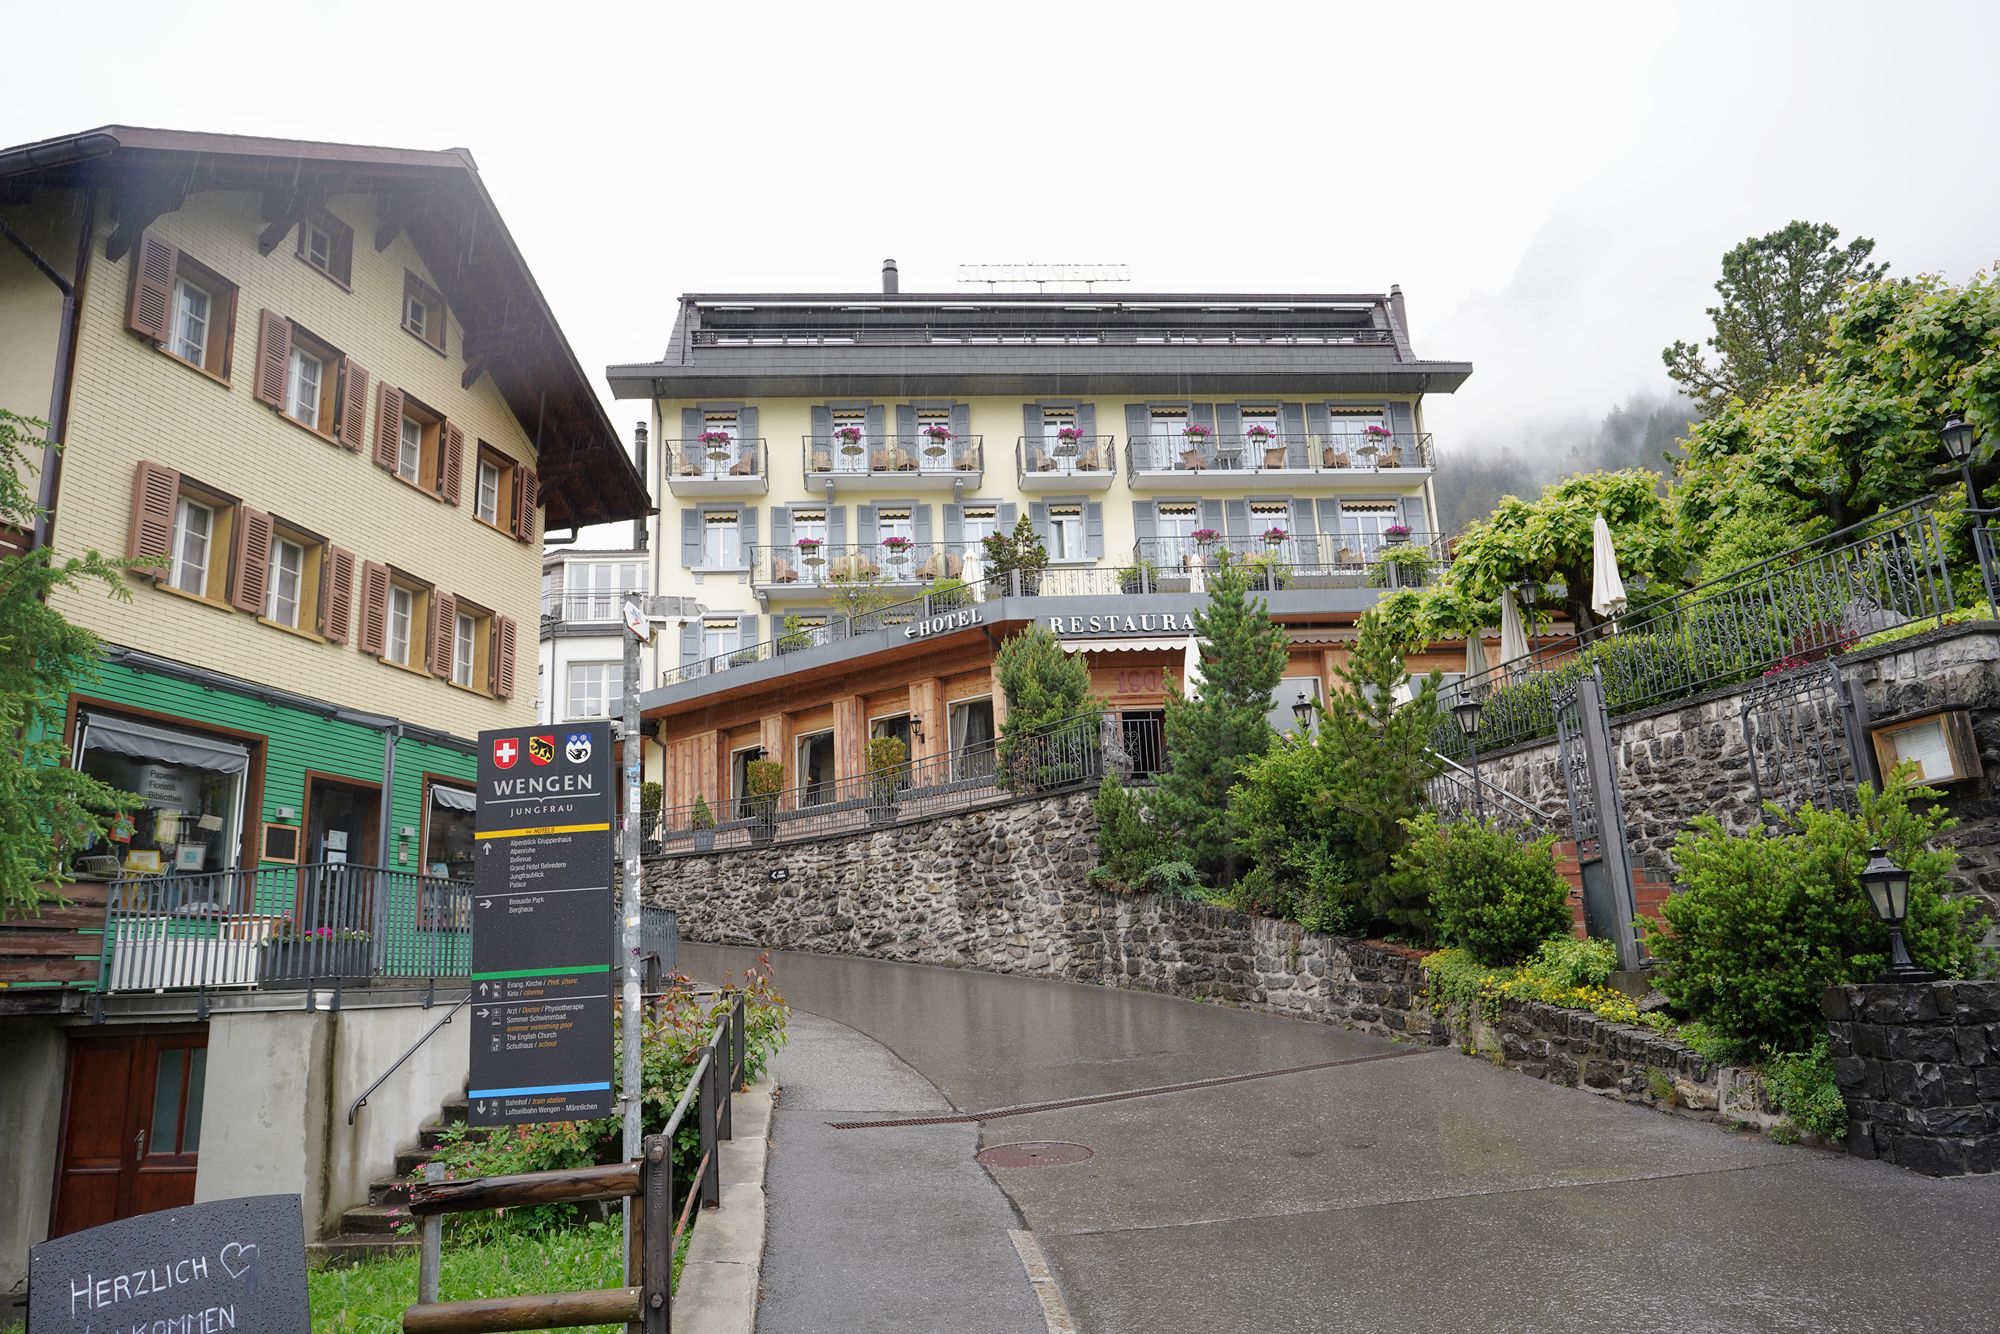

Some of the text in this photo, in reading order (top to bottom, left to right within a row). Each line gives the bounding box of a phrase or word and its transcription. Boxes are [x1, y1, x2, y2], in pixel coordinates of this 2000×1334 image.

[918, 608, 983, 638] HOTEL
[1049, 613, 1208, 635] RESTAURA
[1115, 669, 1168, 693] 190
[150, 780, 176, 791] Floristik
[494, 774, 592, 796] WENGEN
[148, 791, 183, 801] Bibliothek
[510, 804, 573, 818] JUNGFRAU
[533, 827, 555, 835] HOTELS
[510, 837, 572, 847] Alpenblick Gruppenhaus
[510, 848, 536, 856] Alpenruhe
[510, 864, 526, 872] Grand
[541, 862, 566, 870] Belvedere
[510, 871, 544, 880] Jungfraublick
[509, 906, 534, 914] Berghaus
[545, 1003, 584, 1013] Physiotherapie
[506, 1013, 566, 1024] Sommer Schwimmbad
[530, 1022, 560, 1030] swimming
[560, 1022, 573, 1030] pool
[518, 1033, 536, 1041] English
[538, 1031, 557, 1039] Church
[506, 1042, 534, 1050] Schulhaus
[538, 1040, 557, 1048] school
[546, 1096, 566, 1104] station
[506, 1108, 537, 1116] Luftseilbahn
[538, 1106, 560, 1114] Wengen
[566, 1104, 598, 1112] Männlichen
[71, 1255, 208, 1319] HERZLICH
